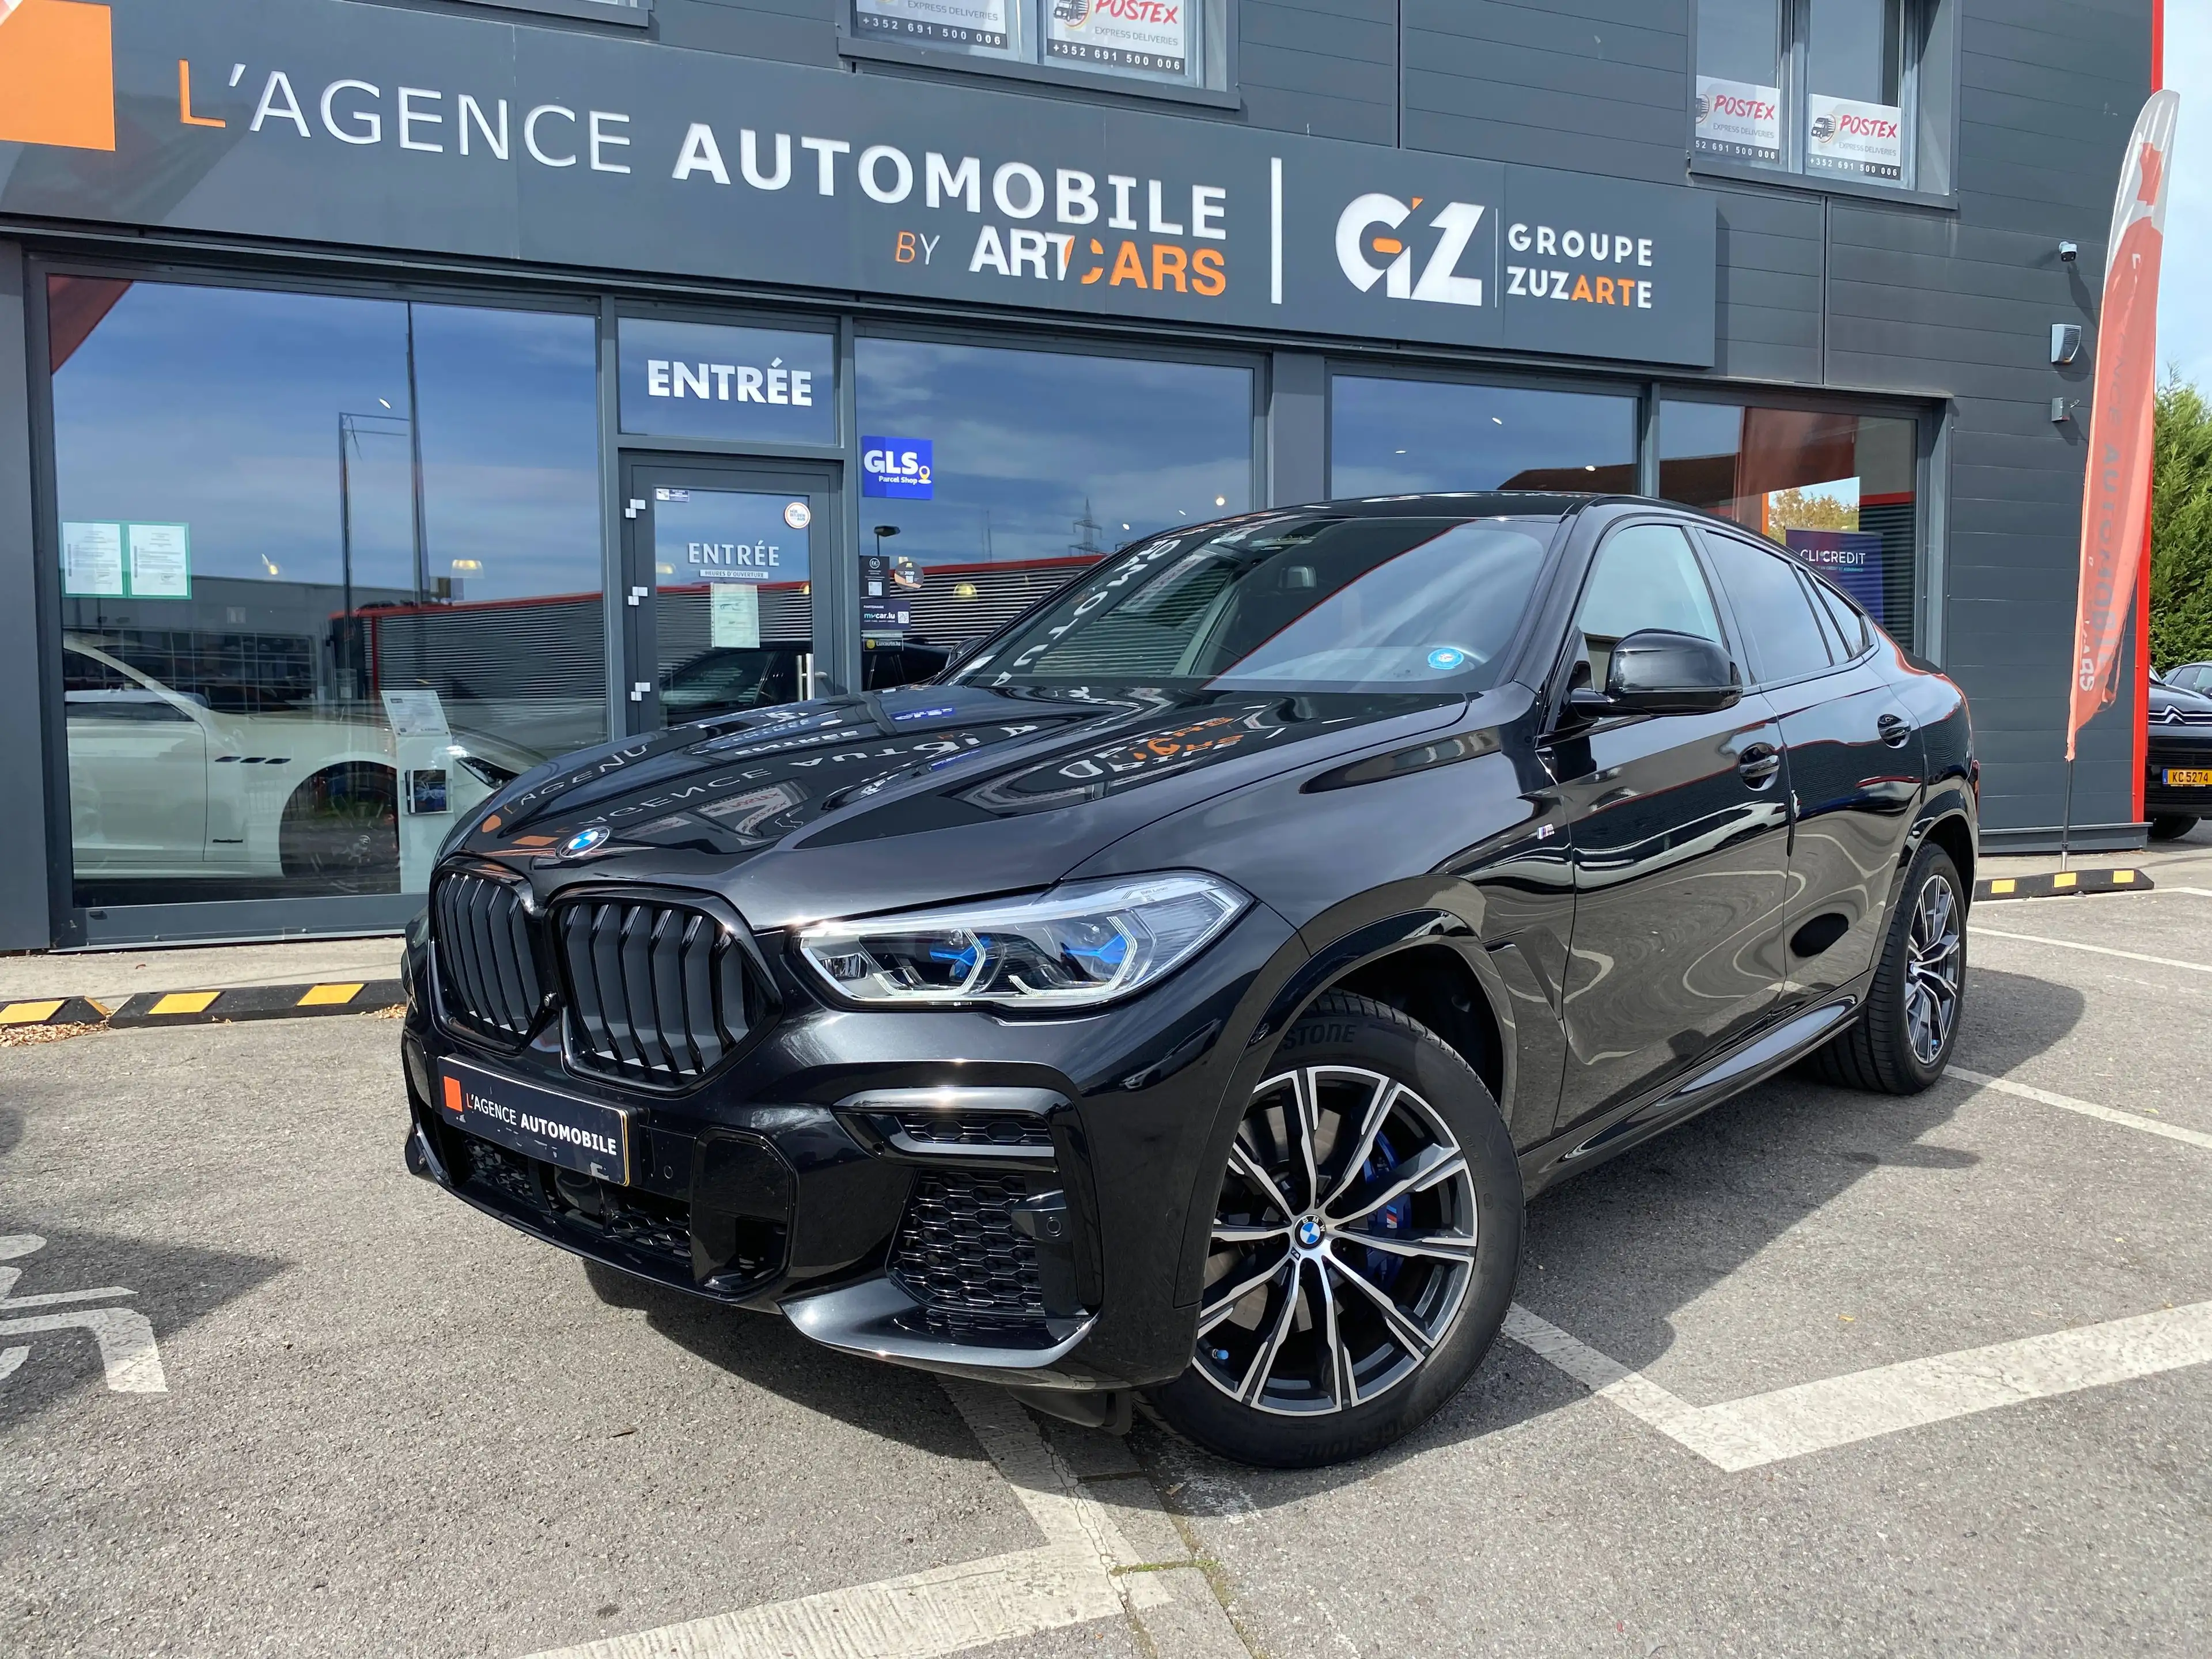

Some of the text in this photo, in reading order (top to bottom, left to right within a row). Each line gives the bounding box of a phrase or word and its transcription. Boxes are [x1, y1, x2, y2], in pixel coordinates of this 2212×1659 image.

[908, 0, 998, 21] EXPRESS DELIVERIES
[1095, 0, 1178, 24] POSTEX
[908, 23, 932, 35] 691
[942, 29, 967, 40] 500
[976, 33, 1001, 46] 006
[1094, 26, 1179, 46] EXPRESS DELIVERIES
[1094, 49, 1118, 61] 691
[1126, 54, 1149, 66] 500
[1157, 58, 1180, 70] 006
[1714, 94, 1775, 120] POSTEX
[1713, 123, 1774, 139] EXPRESS DELIVERIES
[1839, 114, 1897, 138] POSTEX
[179, 58, 1227, 241] L'AGENCE AUTOMOBILE
[1712, 142, 1729, 152] 691
[1735, 146, 1752, 156] 500
[1758, 149, 1775, 160] 006
[1839, 142, 1896, 157] EXPRESS DELIVERIES
[1838, 161, 1854, 170] 691
[1859, 164, 1876, 173] 500
[1881, 167, 1897, 176] 006
[895, 230, 941, 266] BY
[1508, 222, 1653, 267] GROUPE
[1506, 265, 1652, 309] ZUZARTE
[647, 357, 812, 407] ENTRÉE
[864, 449, 919, 475] GLS
[900, 476, 918, 485] Shop
[688, 540, 780, 567] ENTRÉE
[2173, 772, 2208, 782] KC 5274
[465, 1093, 618, 1156] L'AGENCE AUTOMOBILE
[1302, 1216, 1326, 1232] BMW
